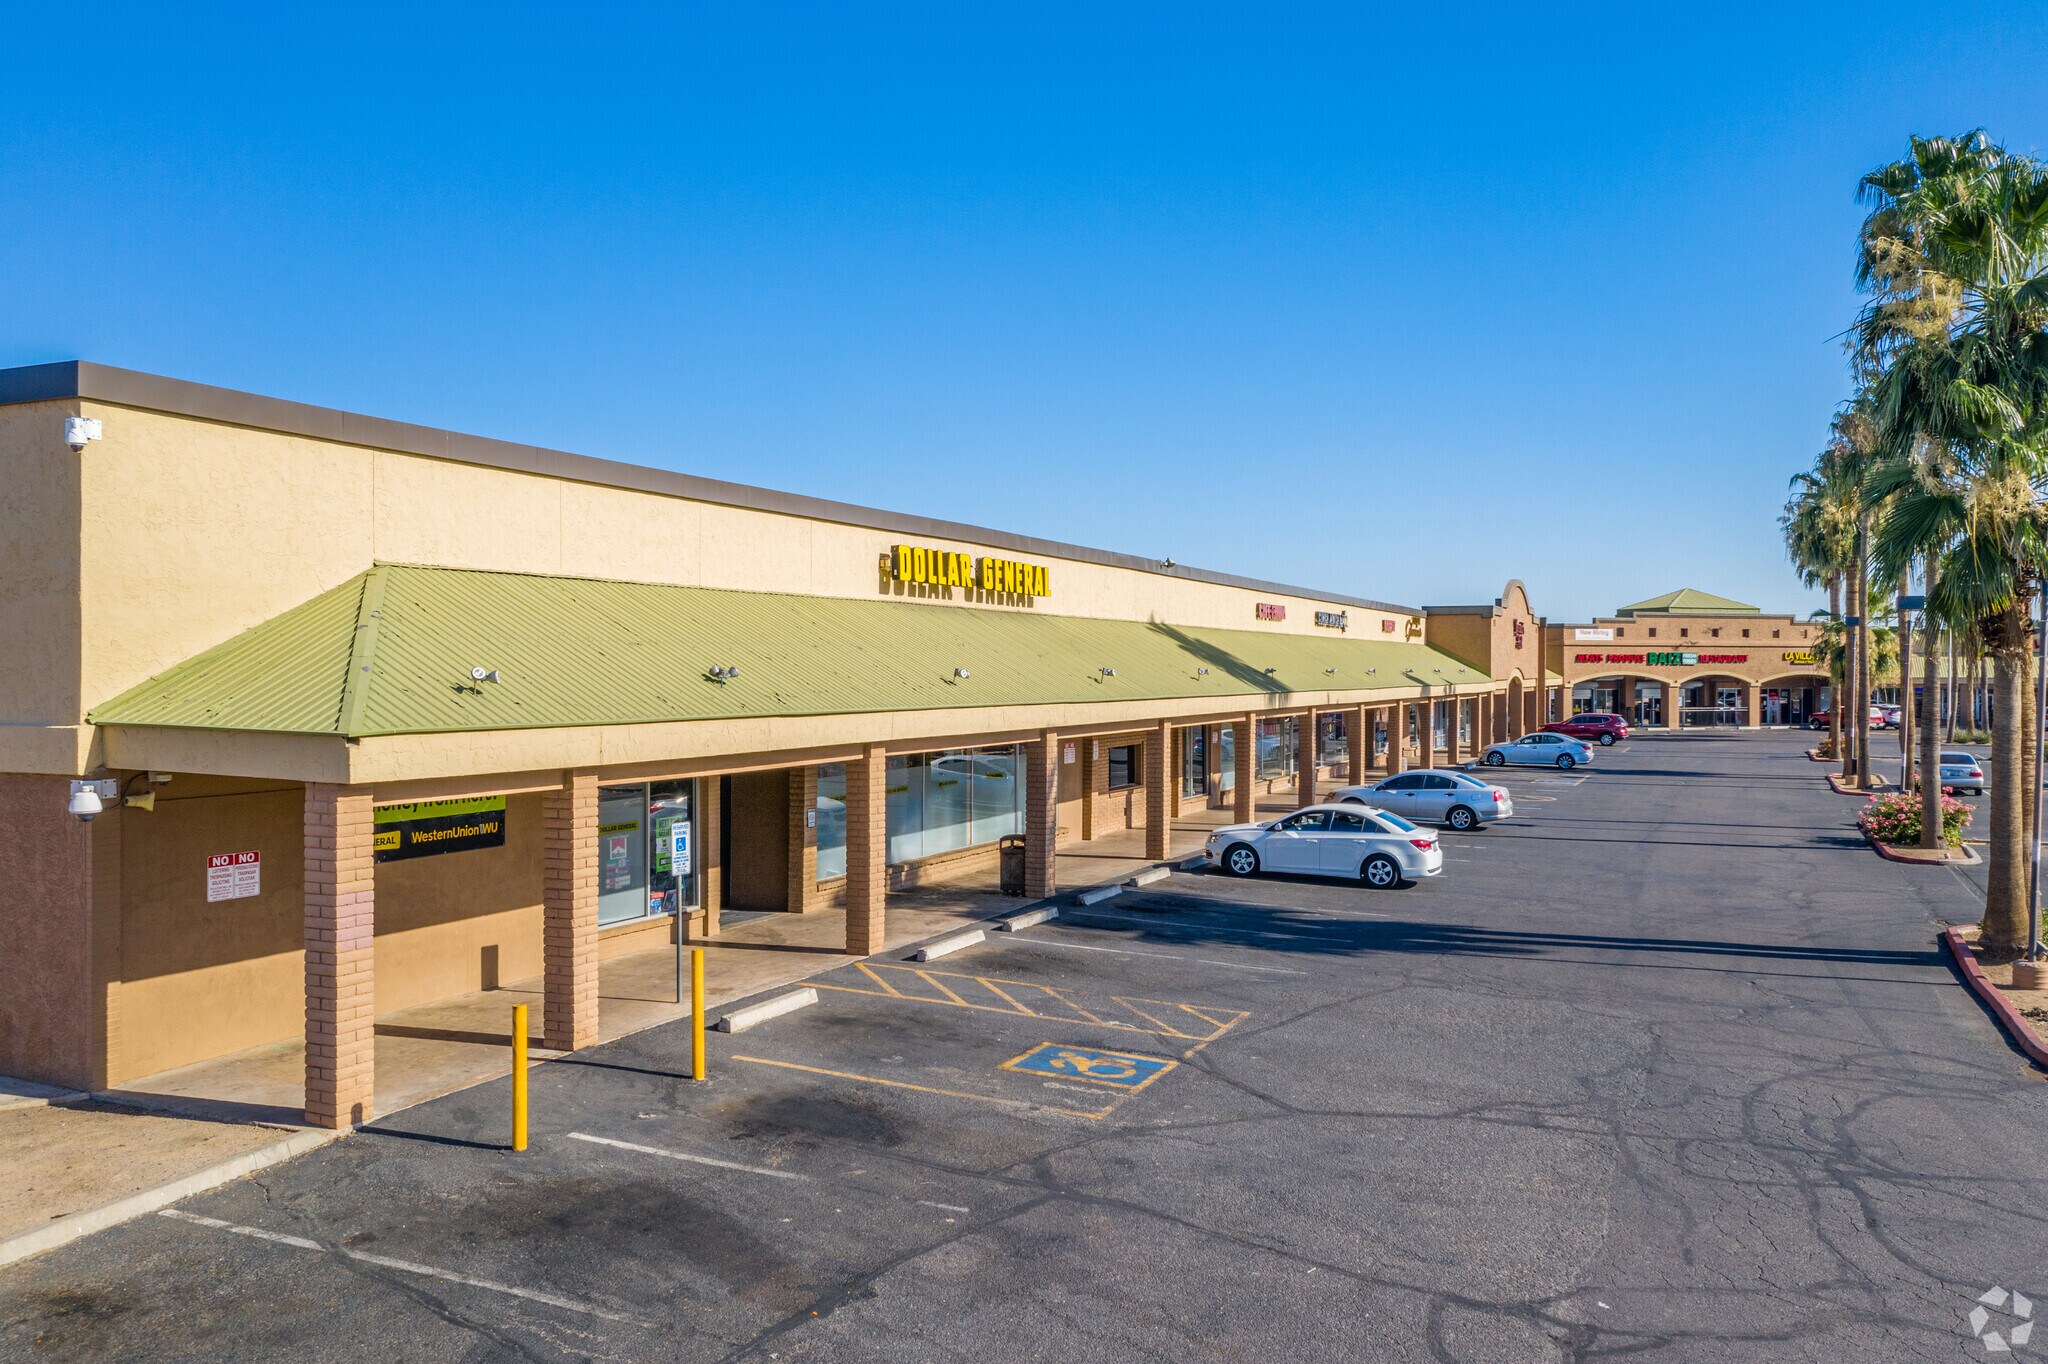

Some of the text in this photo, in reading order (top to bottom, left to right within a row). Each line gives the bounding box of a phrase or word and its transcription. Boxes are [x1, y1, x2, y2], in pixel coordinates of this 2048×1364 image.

[894, 544, 1052, 597] DOLLAR GENERAL
[1576, 652, 1682, 665] MEATS PRODUCE BAIZ
[1699, 654, 1749, 664] RESTAURANT
[212, 856, 229, 866] NO
[238, 853, 255, 863] NO
